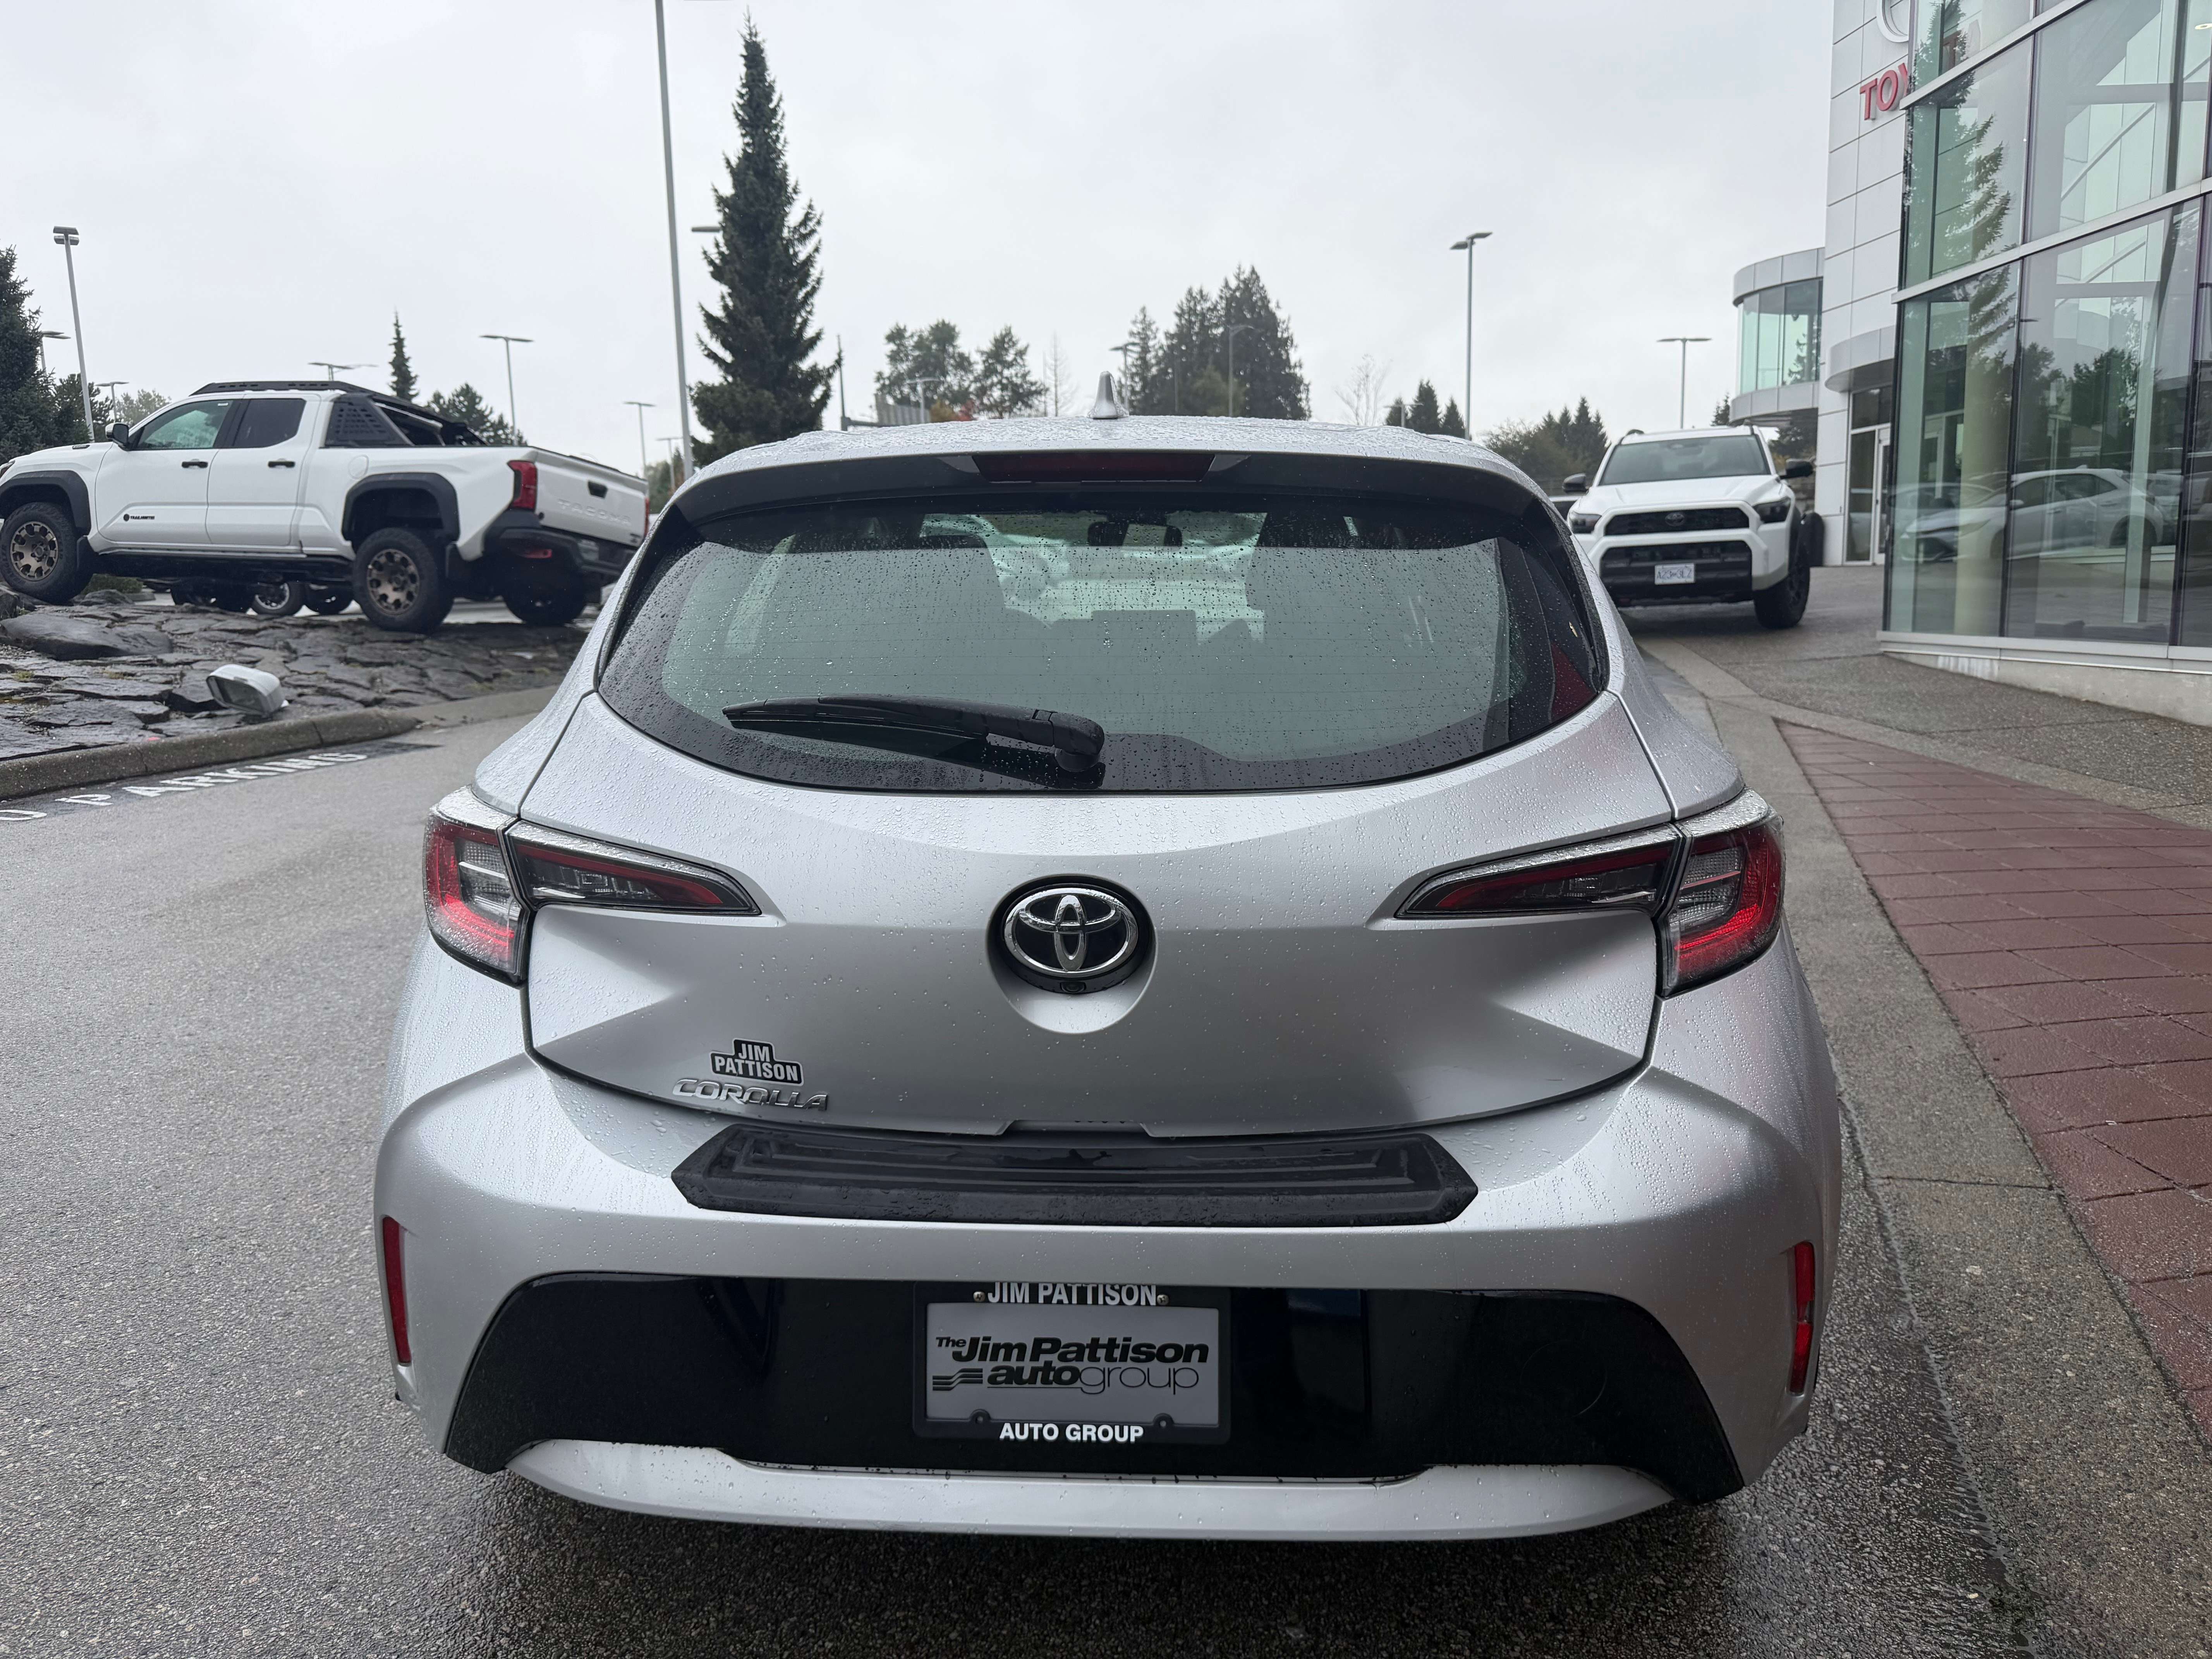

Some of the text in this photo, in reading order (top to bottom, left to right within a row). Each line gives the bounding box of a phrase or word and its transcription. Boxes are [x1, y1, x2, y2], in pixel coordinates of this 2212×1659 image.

[738, 1043, 770, 1062] JIM
[714, 1056, 798, 1081] PATTISON
[672, 1079, 828, 1111] COROLLA
[988, 1281, 1156, 1306] JIM PATTISON
[936, 1336, 966, 1348] The
[999, 1422, 1144, 1443] AUTO GROUP
